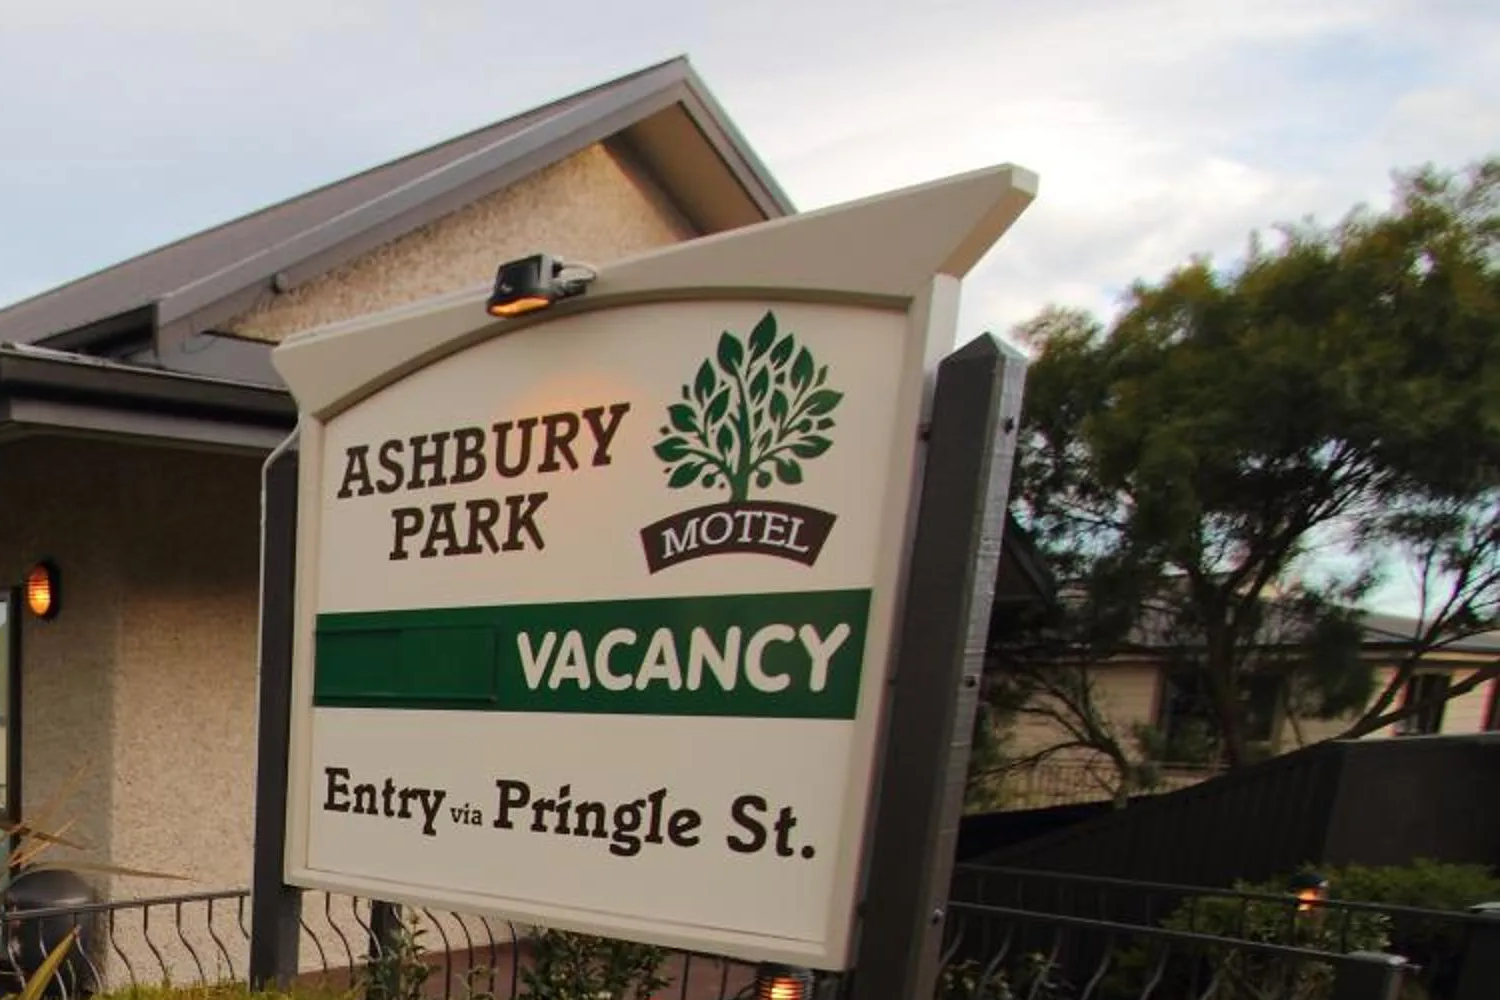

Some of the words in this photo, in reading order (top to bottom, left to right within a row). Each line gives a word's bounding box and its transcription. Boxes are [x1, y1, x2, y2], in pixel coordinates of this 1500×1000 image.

[337, 402, 630, 499] ASHBURY
[388, 491, 549, 561] PARK
[660, 511, 810, 559] MOTEL
[516, 622, 851, 692] VACANCY
[323, 766, 446, 835] Entry
[450, 802, 483, 827] via
[493, 778, 702, 857] Pringle
[726, 795, 816, 859] St.
